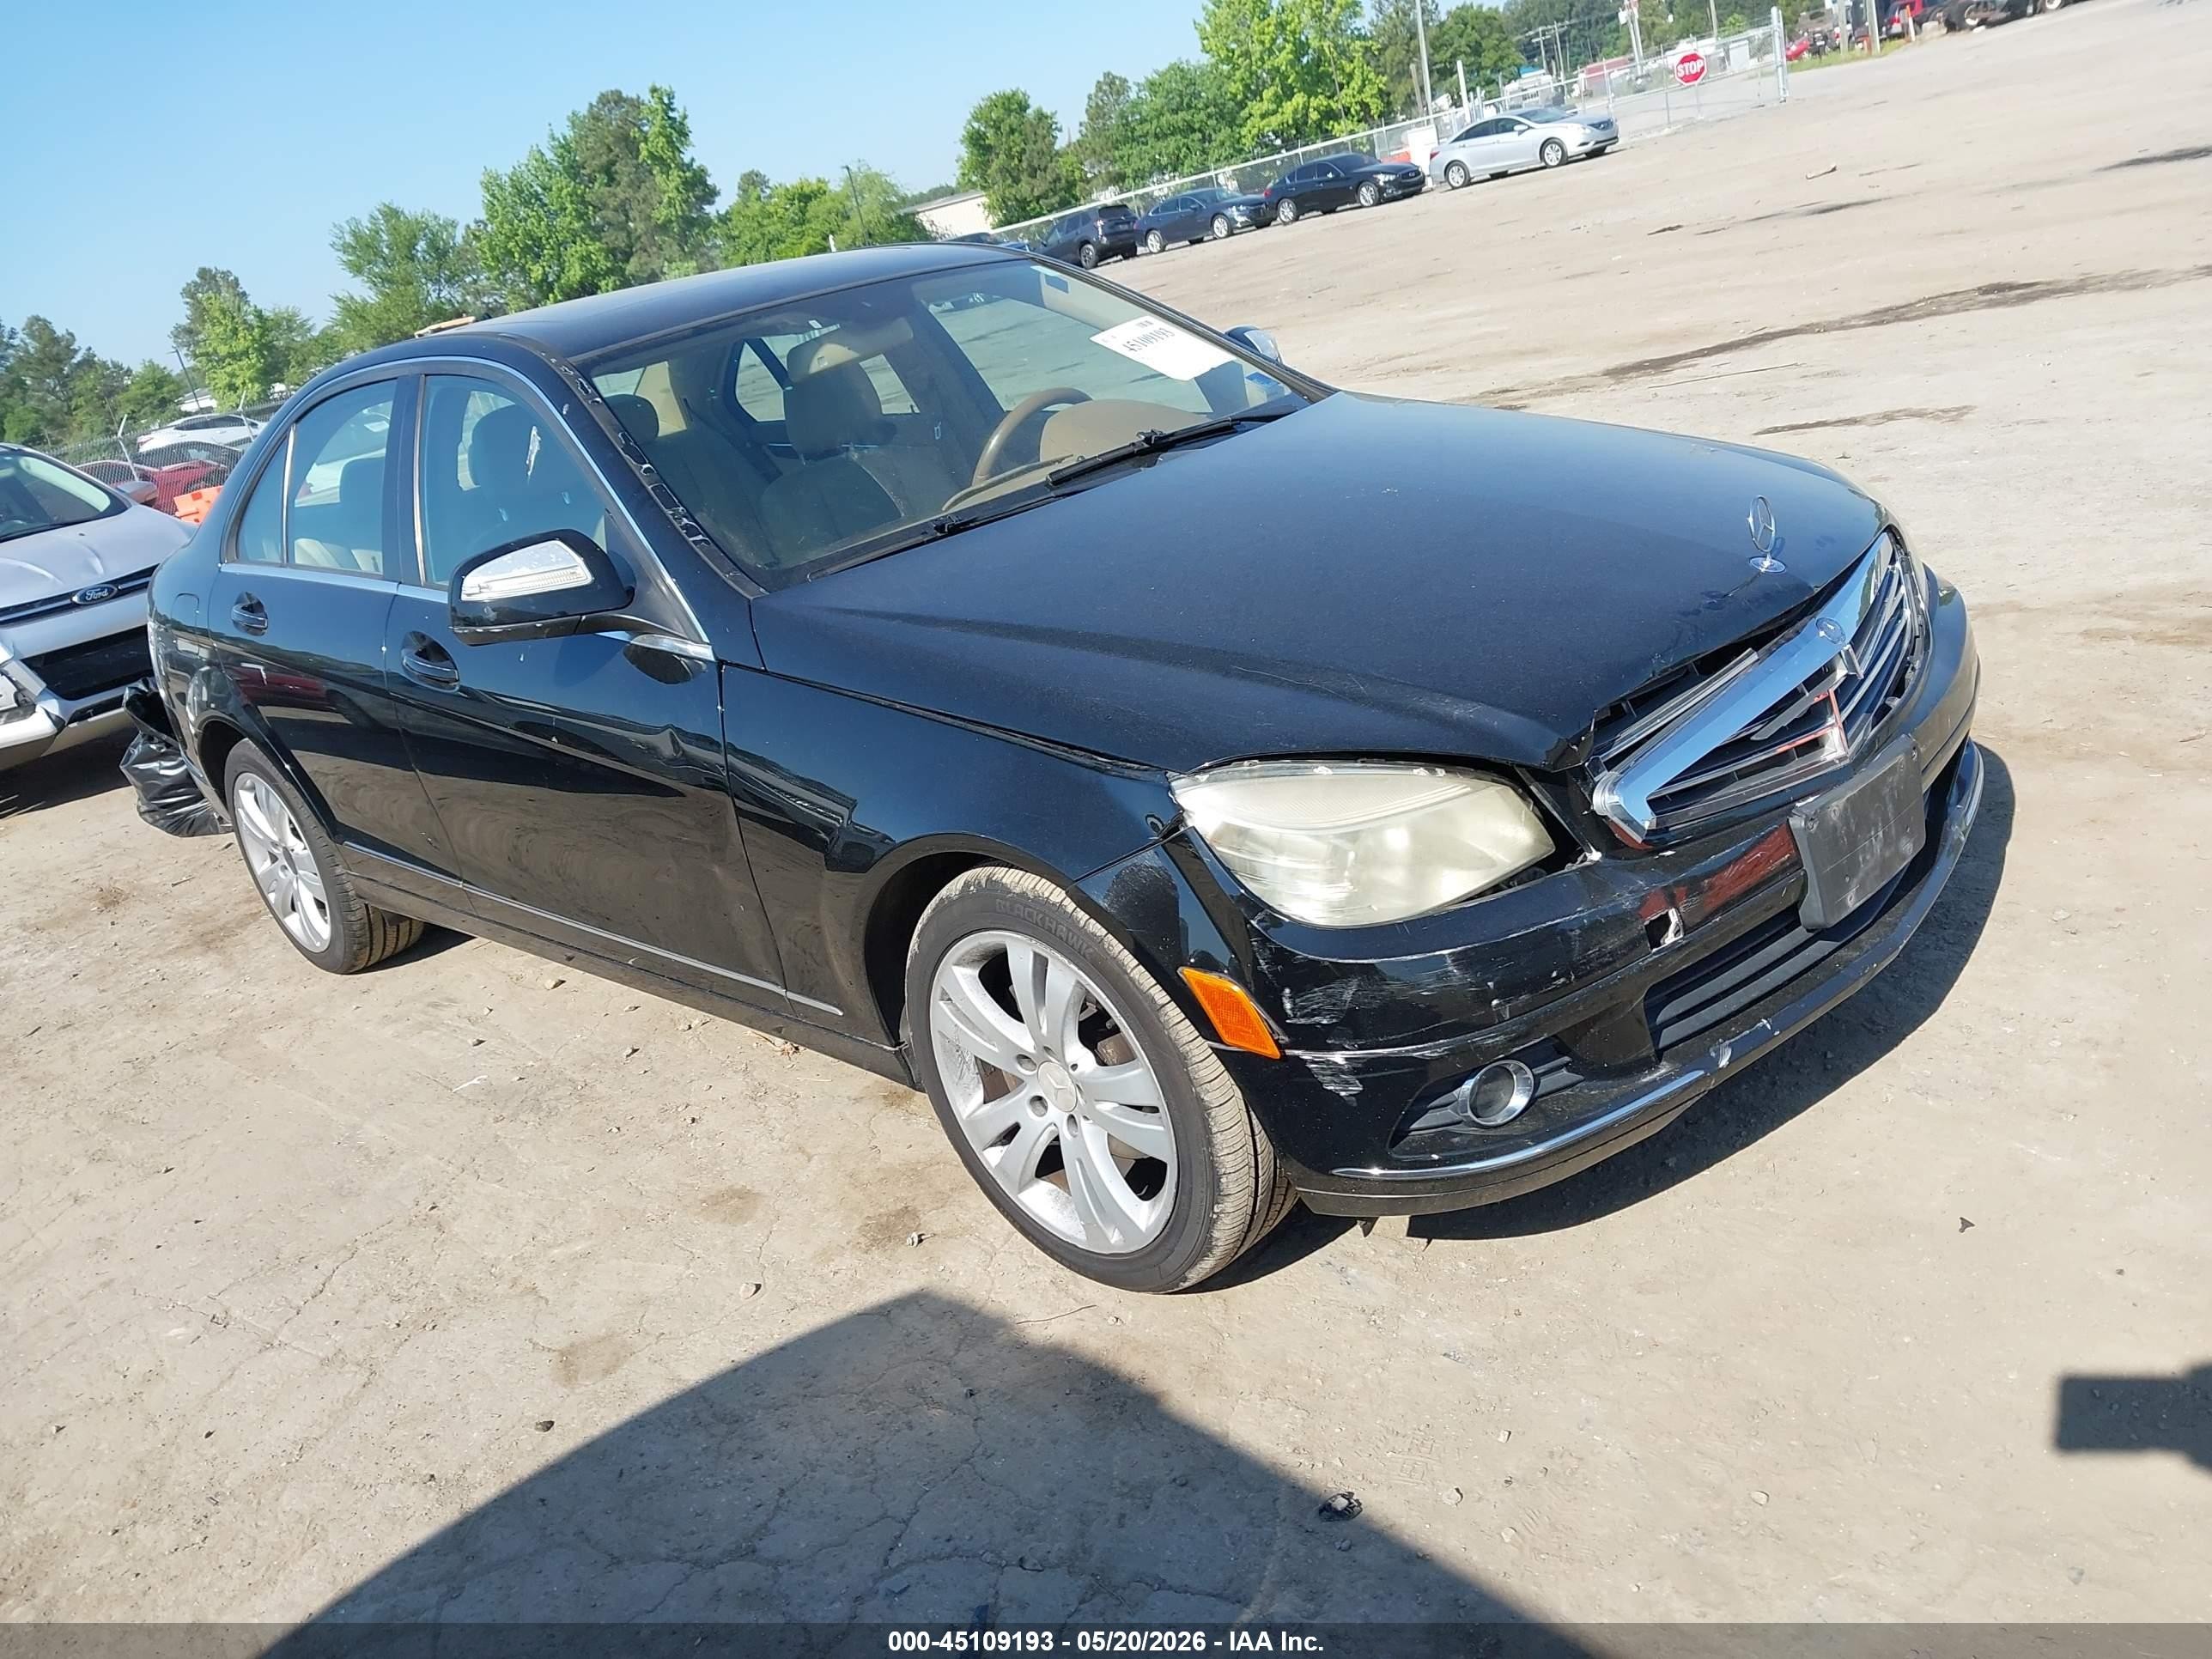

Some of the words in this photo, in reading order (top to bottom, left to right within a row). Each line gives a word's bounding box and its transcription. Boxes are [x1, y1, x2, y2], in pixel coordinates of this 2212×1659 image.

[1677, 59, 1705, 78] STOP
[85, 587, 109, 601] Ford
[995, 898, 1096, 960] BLACKHAWK
